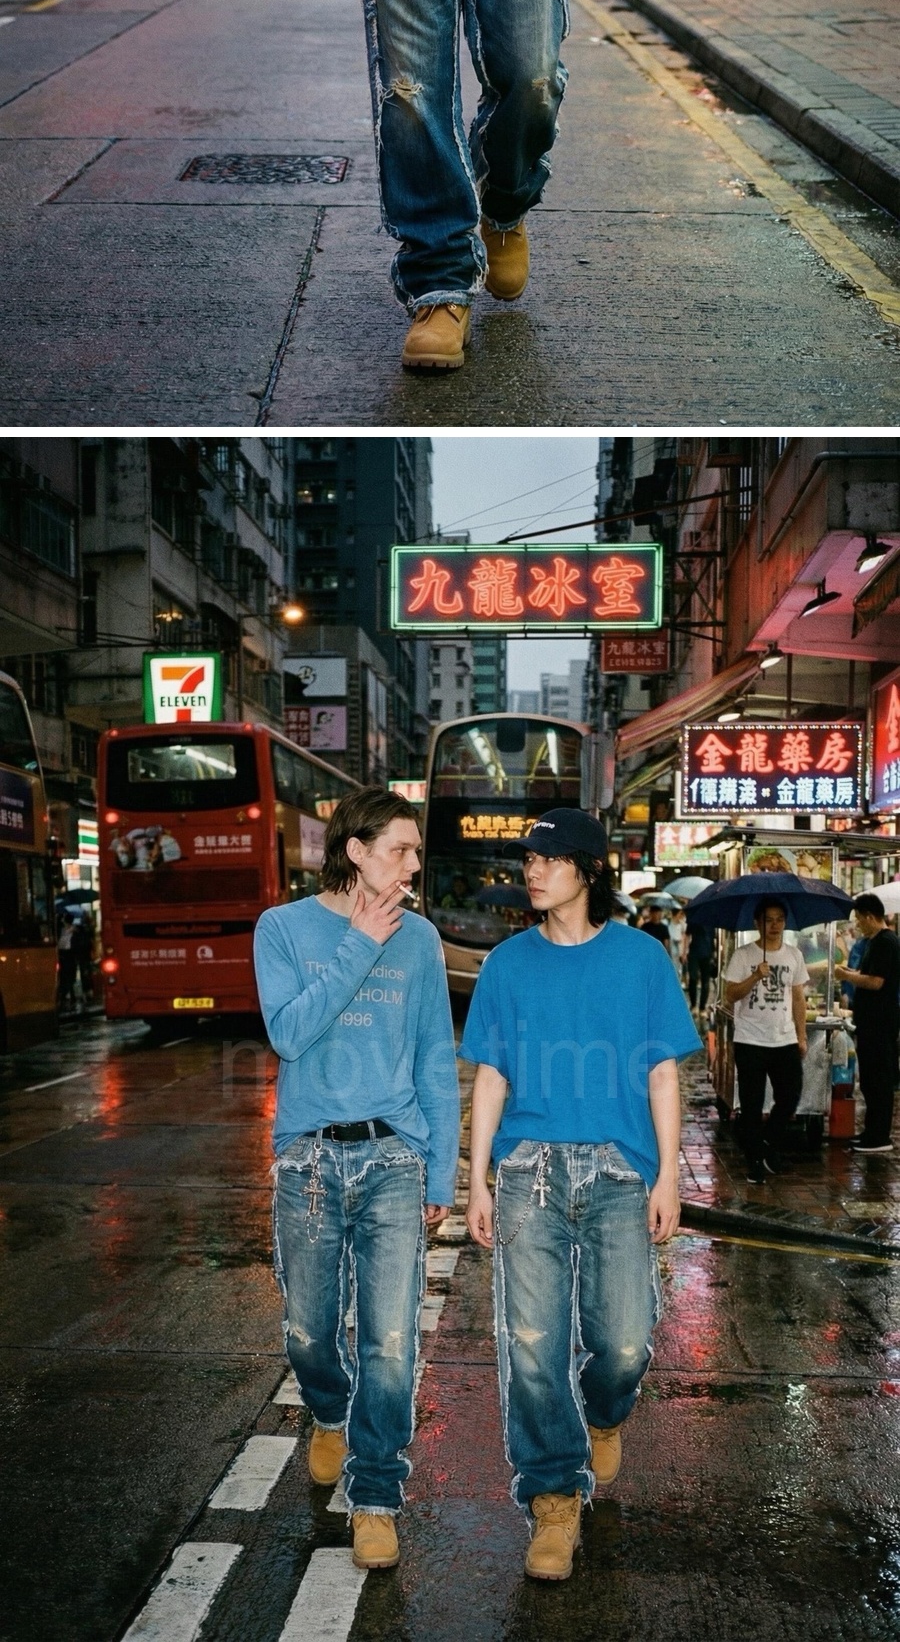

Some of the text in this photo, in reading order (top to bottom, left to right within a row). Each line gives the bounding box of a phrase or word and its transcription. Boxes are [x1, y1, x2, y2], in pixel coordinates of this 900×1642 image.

[408, 558, 645, 616] 九龍冰室
[695, 731, 853, 774] 金龍藥房
[777, 777, 854, 805] 金龍藥房
